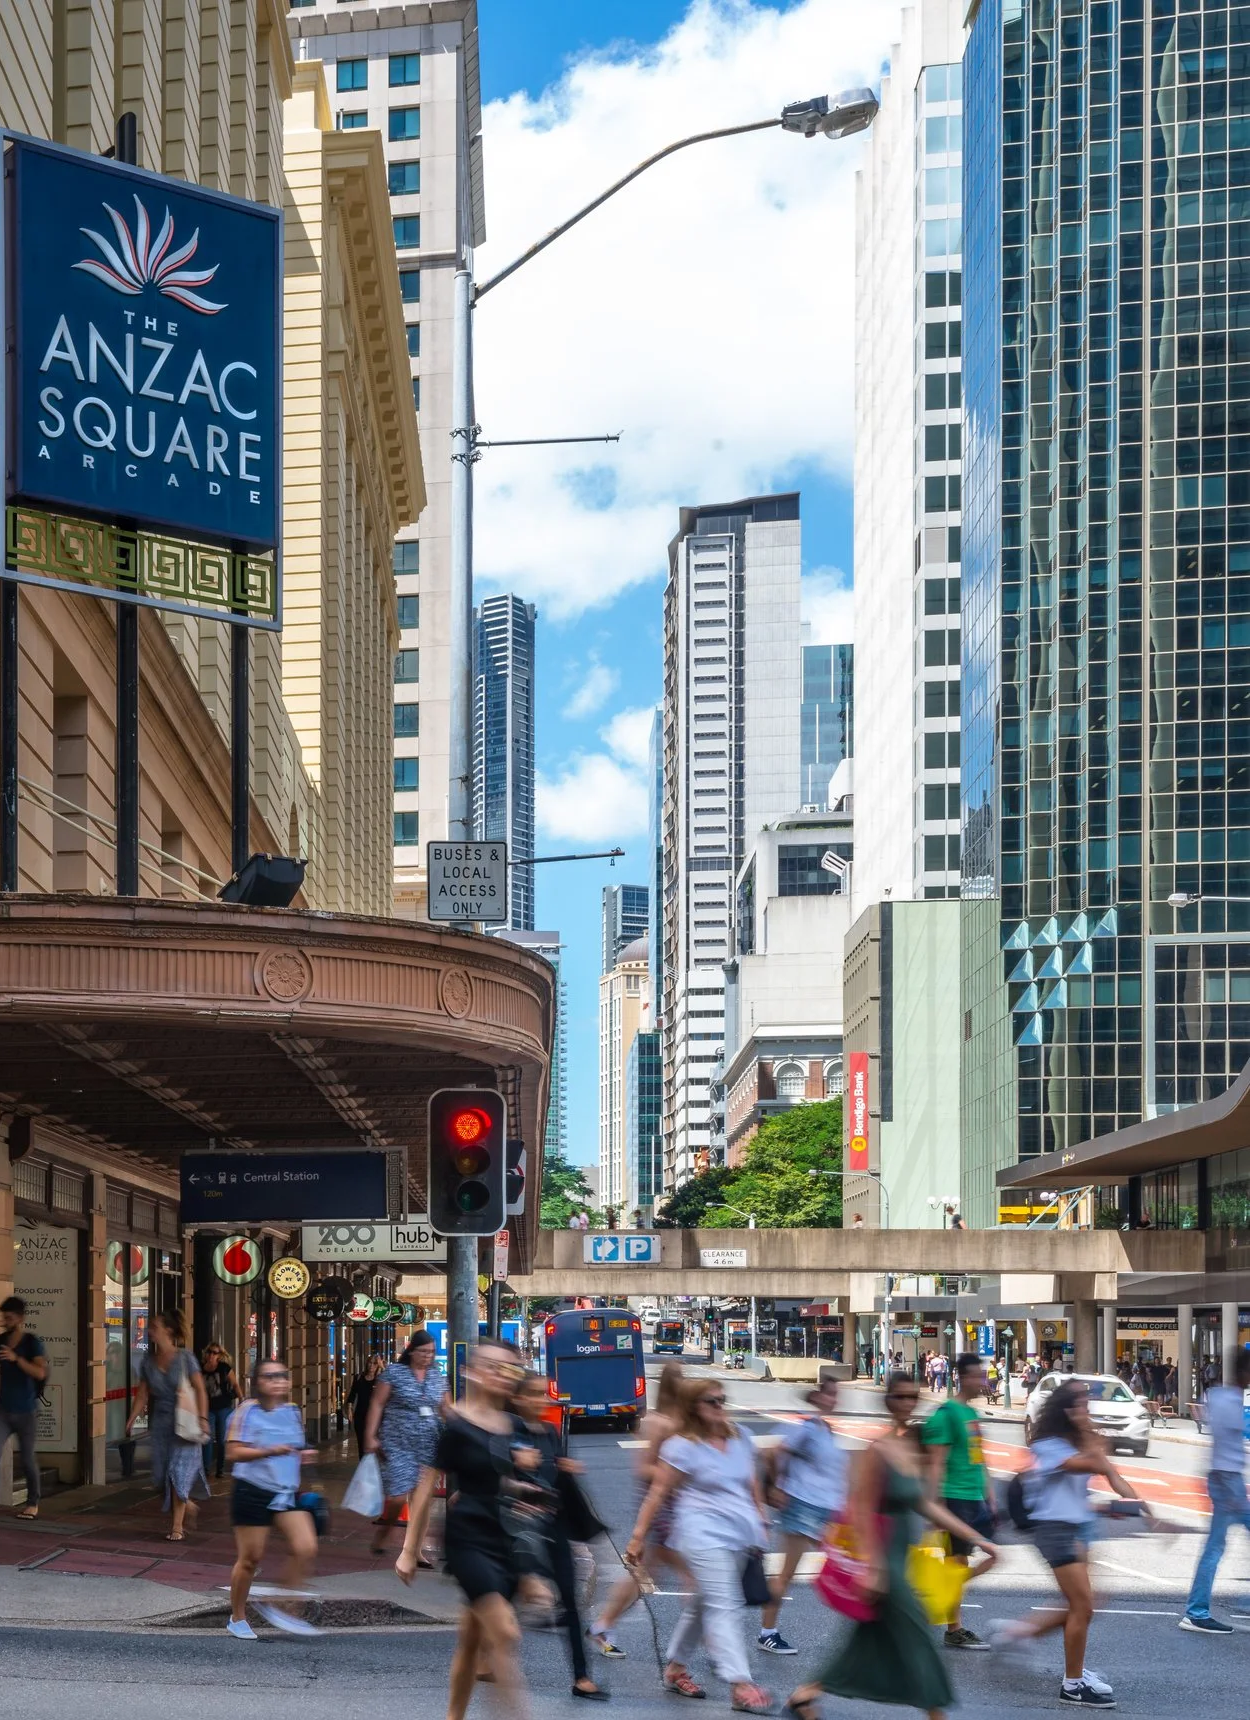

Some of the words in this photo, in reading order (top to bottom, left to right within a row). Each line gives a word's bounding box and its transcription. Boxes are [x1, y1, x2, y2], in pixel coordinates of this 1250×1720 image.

[124, 310, 178, 336] THE
[39, 313, 257, 421] ANZAC
[38, 386, 261, 483] SQUARE
[38, 444, 261, 504] ARCADE
[434, 848, 482, 861] BUSES
[490, 848, 500, 861] &
[443, 866, 492, 879] LOCAL
[438, 884, 497, 897] ACCESS
[452, 901, 483, 914] ONLY
[853, 1071, 864, 1096] Bank
[853, 1096, 866, 1136] Bendigo
[243, 1172, 281, 1182] Central
[283, 1171, 320, 1181] Station
[319, 1225, 376, 1246] 200
[396, 1226, 430, 1243] hub
[19, 1237, 68, 1250] ANZAC
[17, 1251, 68, 1261] SQUARE
[275, 1266, 302, 1282] FLOWERS
[589, 1318, 599, 1330] 40
[1127, 1322, 1148, 1330] GRAB
[1150, 1322, 1178, 1330] COFFEE
